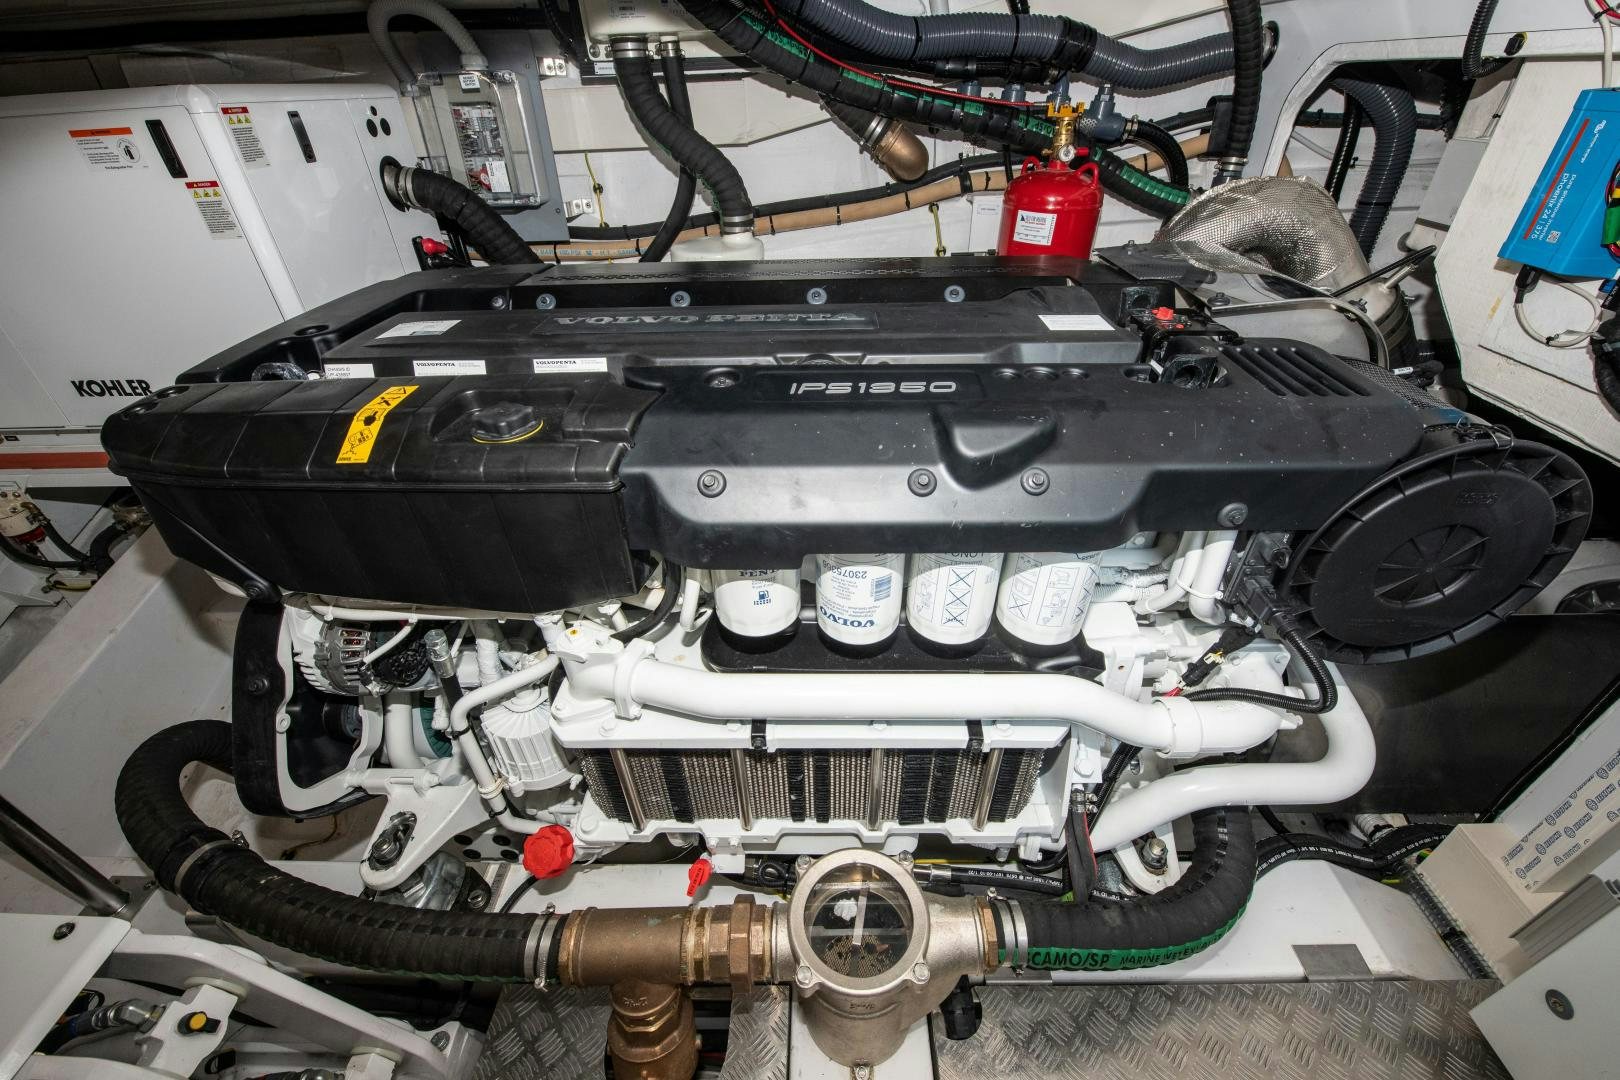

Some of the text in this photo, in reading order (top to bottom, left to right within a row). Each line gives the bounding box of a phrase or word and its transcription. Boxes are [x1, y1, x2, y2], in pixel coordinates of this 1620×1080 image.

[1548, 173, 1570, 208] phoenix
[1542, 208, 1551, 219] 24
[1531, 224, 1542, 239] 375
[553, 312, 866, 325] VOLVO PENTA
[70, 379, 153, 397] KOHLER
[820, 606, 875, 628] VOLVO
[1119, 953, 1160, 966] MARINE
